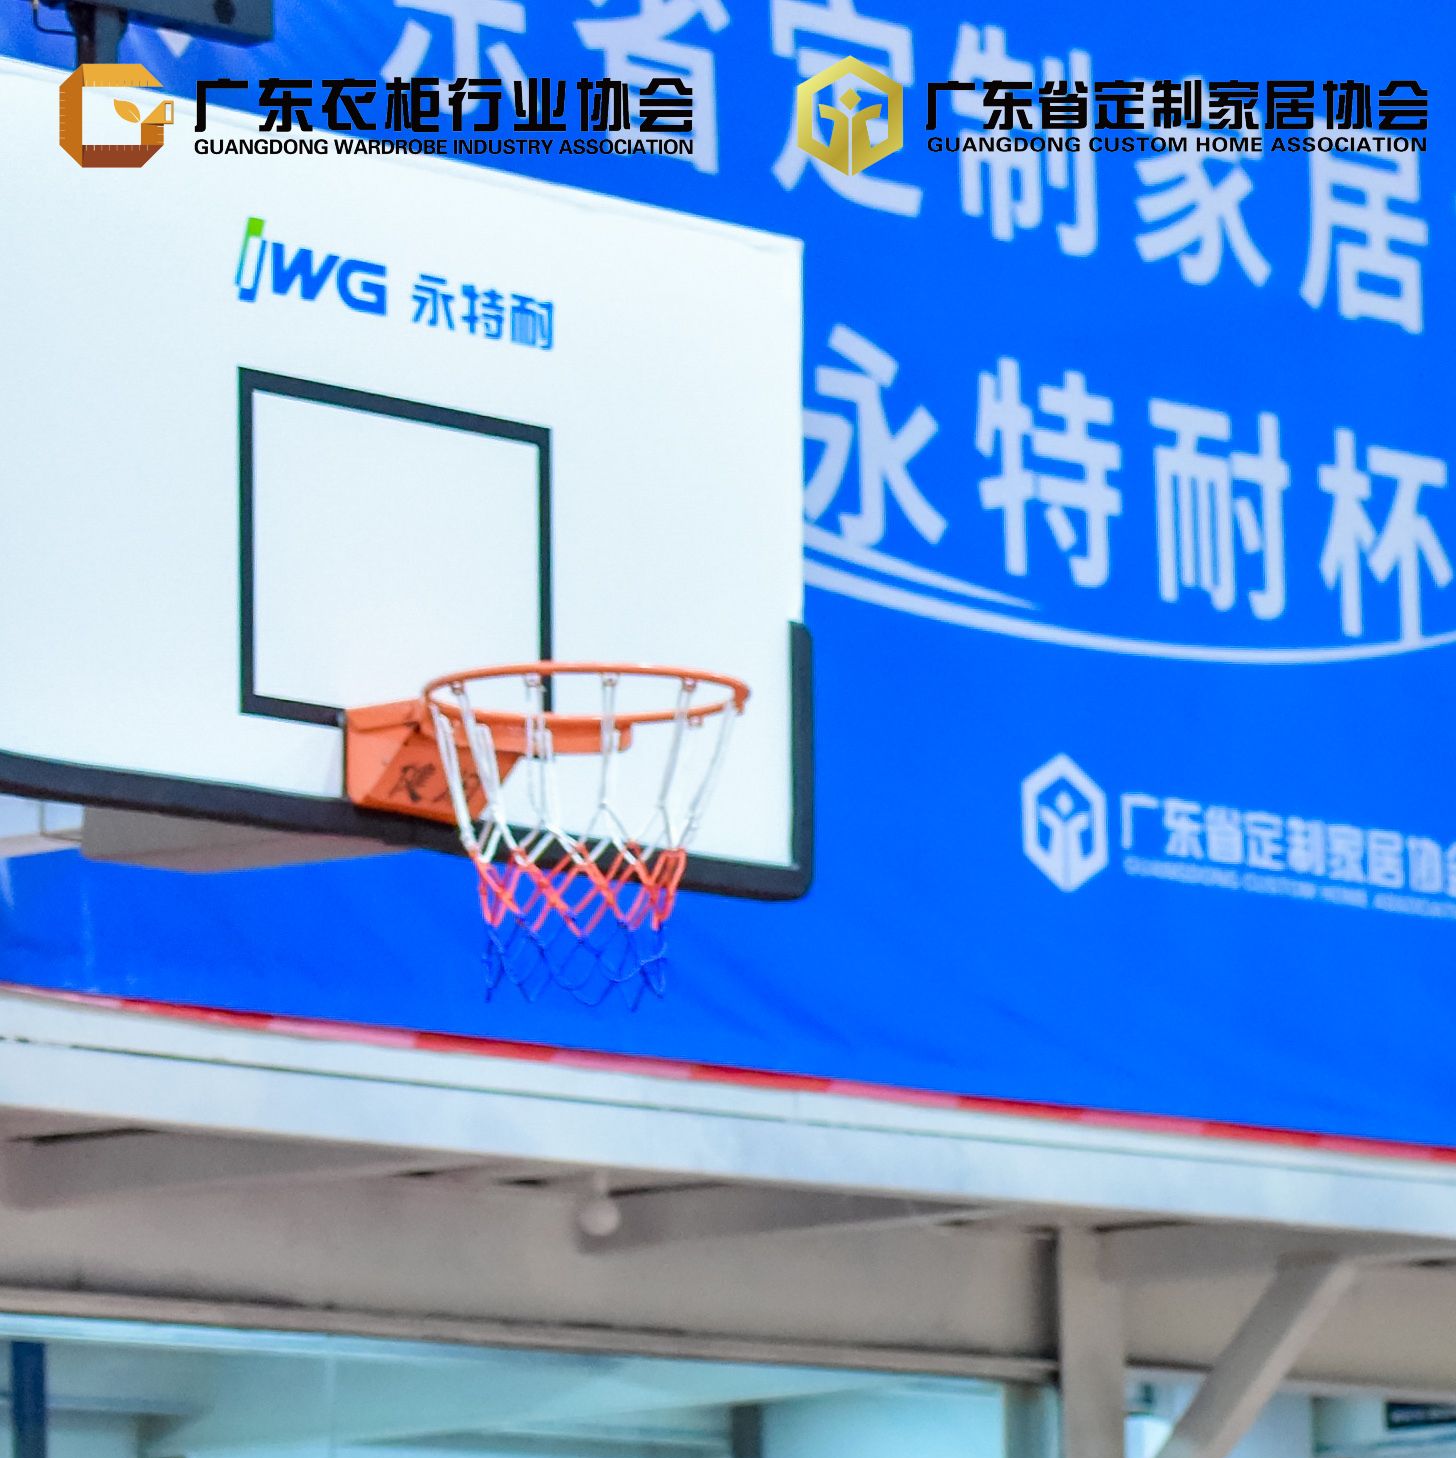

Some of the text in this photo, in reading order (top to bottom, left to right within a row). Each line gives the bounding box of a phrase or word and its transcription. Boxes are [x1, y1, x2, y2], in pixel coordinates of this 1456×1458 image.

[411, 273, 553, 351] 永特耐
[803, 323, 1454, 647] 永特耐杯
